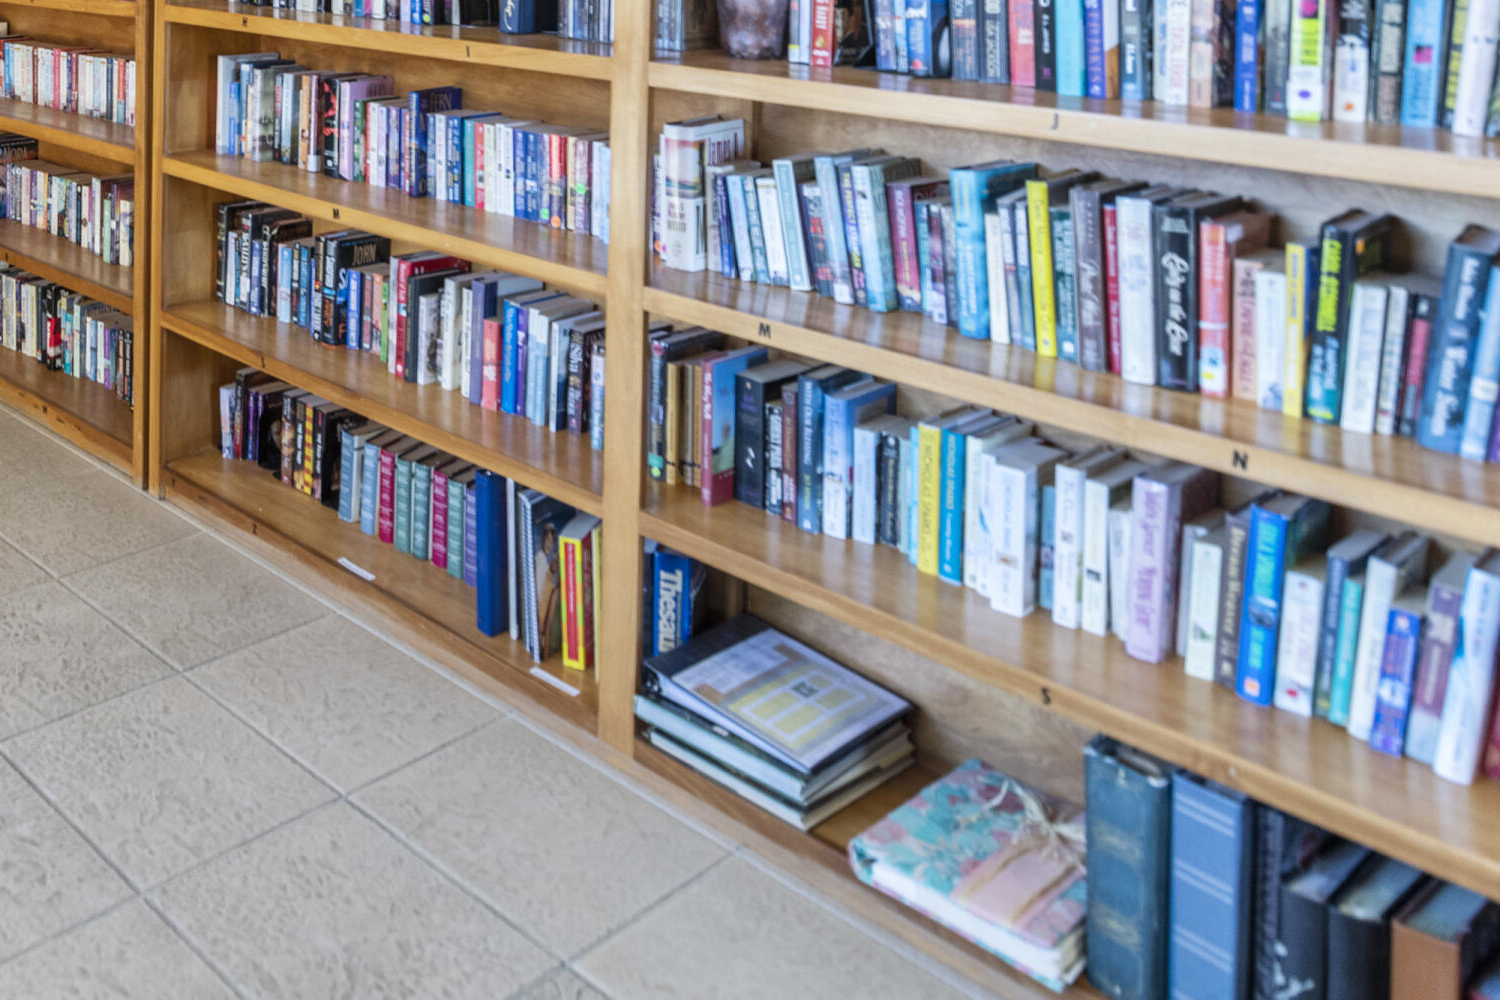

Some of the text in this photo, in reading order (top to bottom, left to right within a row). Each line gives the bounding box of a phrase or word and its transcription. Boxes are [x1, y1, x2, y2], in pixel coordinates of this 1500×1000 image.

[242, 17, 248, 27] H
[1052, 114, 1059, 130] J
[3, 146, 27, 163] NORA
[843, 172, 853, 188] THE
[844, 190, 856, 225] PERFECT
[353, 243, 377, 265] JOHN
[759, 322, 772, 339] M
[569, 343, 583, 372] Silva
[947, 434, 957, 479] NICHOLAS
[1232, 450, 1248, 470] N
[923, 444, 933, 535] NICHOLAS SPARKS
[946, 479, 956, 510] SPARKS
[658, 568, 683, 653] Thesau
[1042, 687, 1051, 705] S
